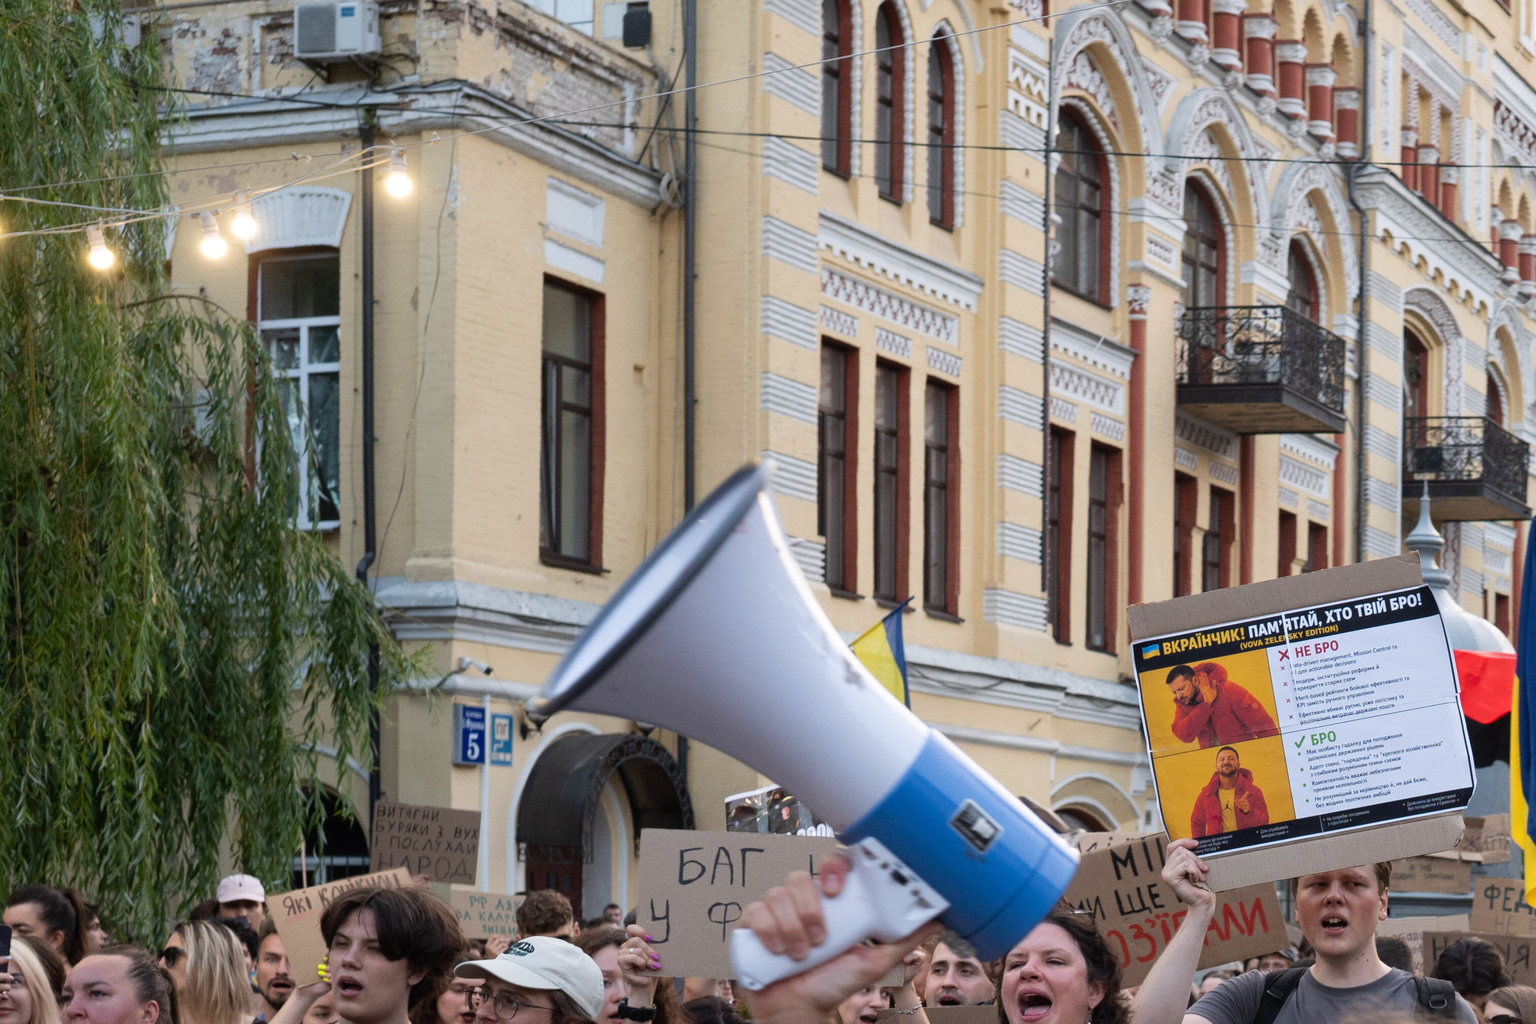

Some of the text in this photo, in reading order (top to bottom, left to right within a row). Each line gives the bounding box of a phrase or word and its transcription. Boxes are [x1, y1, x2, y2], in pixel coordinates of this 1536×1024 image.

[1163, 627, 1246, 656] ВКРАЇНЧИК!
[1325, 606, 1353, 624] ХТО
[1355, 597, 1387, 618] ТВІЙ
[1389, 592, 1422, 612] БРО!
[1240, 638, 1263, 650] (VOVA
[1305, 624, 1339, 637] EDITION)
[1295, 640, 1339, 658] НЕ БРО
[467, 732, 480, 760] 5
[1310, 730, 1337, 746] БРО
[377, 804, 440, 822] ВИТЯГНИ
[375, 819, 429, 836] БУРЯКИ
[454, 826, 479, 840] ВУХ
[377, 853, 472, 881] НАРОД
[678, 846, 765, 888] БАГ
[1113, 883, 1165, 916] ЩЕ
[650, 898, 742, 944] У Ф
